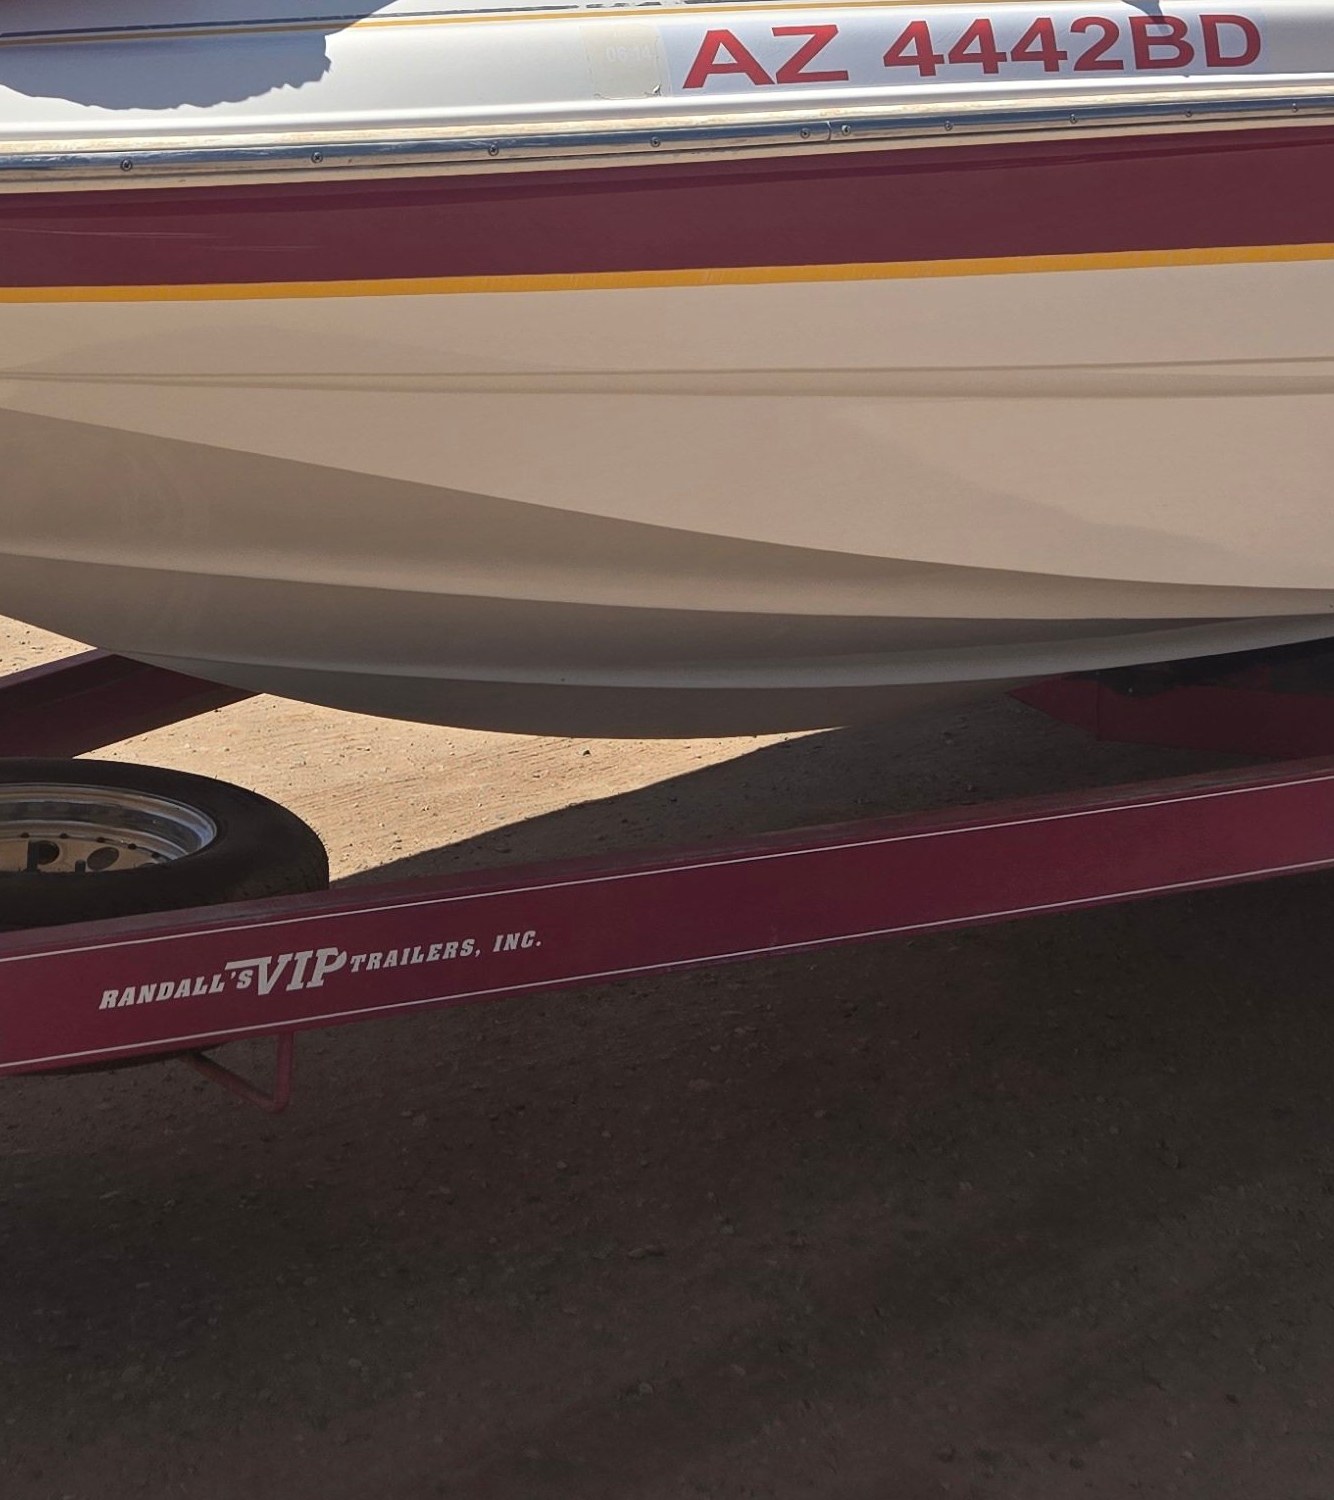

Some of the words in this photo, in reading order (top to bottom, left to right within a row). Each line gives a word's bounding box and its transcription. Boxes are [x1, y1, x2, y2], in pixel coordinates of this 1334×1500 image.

[682, 23, 850, 90] AZ
[883, 13, 1262, 77] 4442BD
[99, 968, 254, 1010] RANDALL'S
[226, 946, 347, 996] VIP
[350, 937, 482, 974] TRAILERS,
[493, 929, 543, 953] INC.
